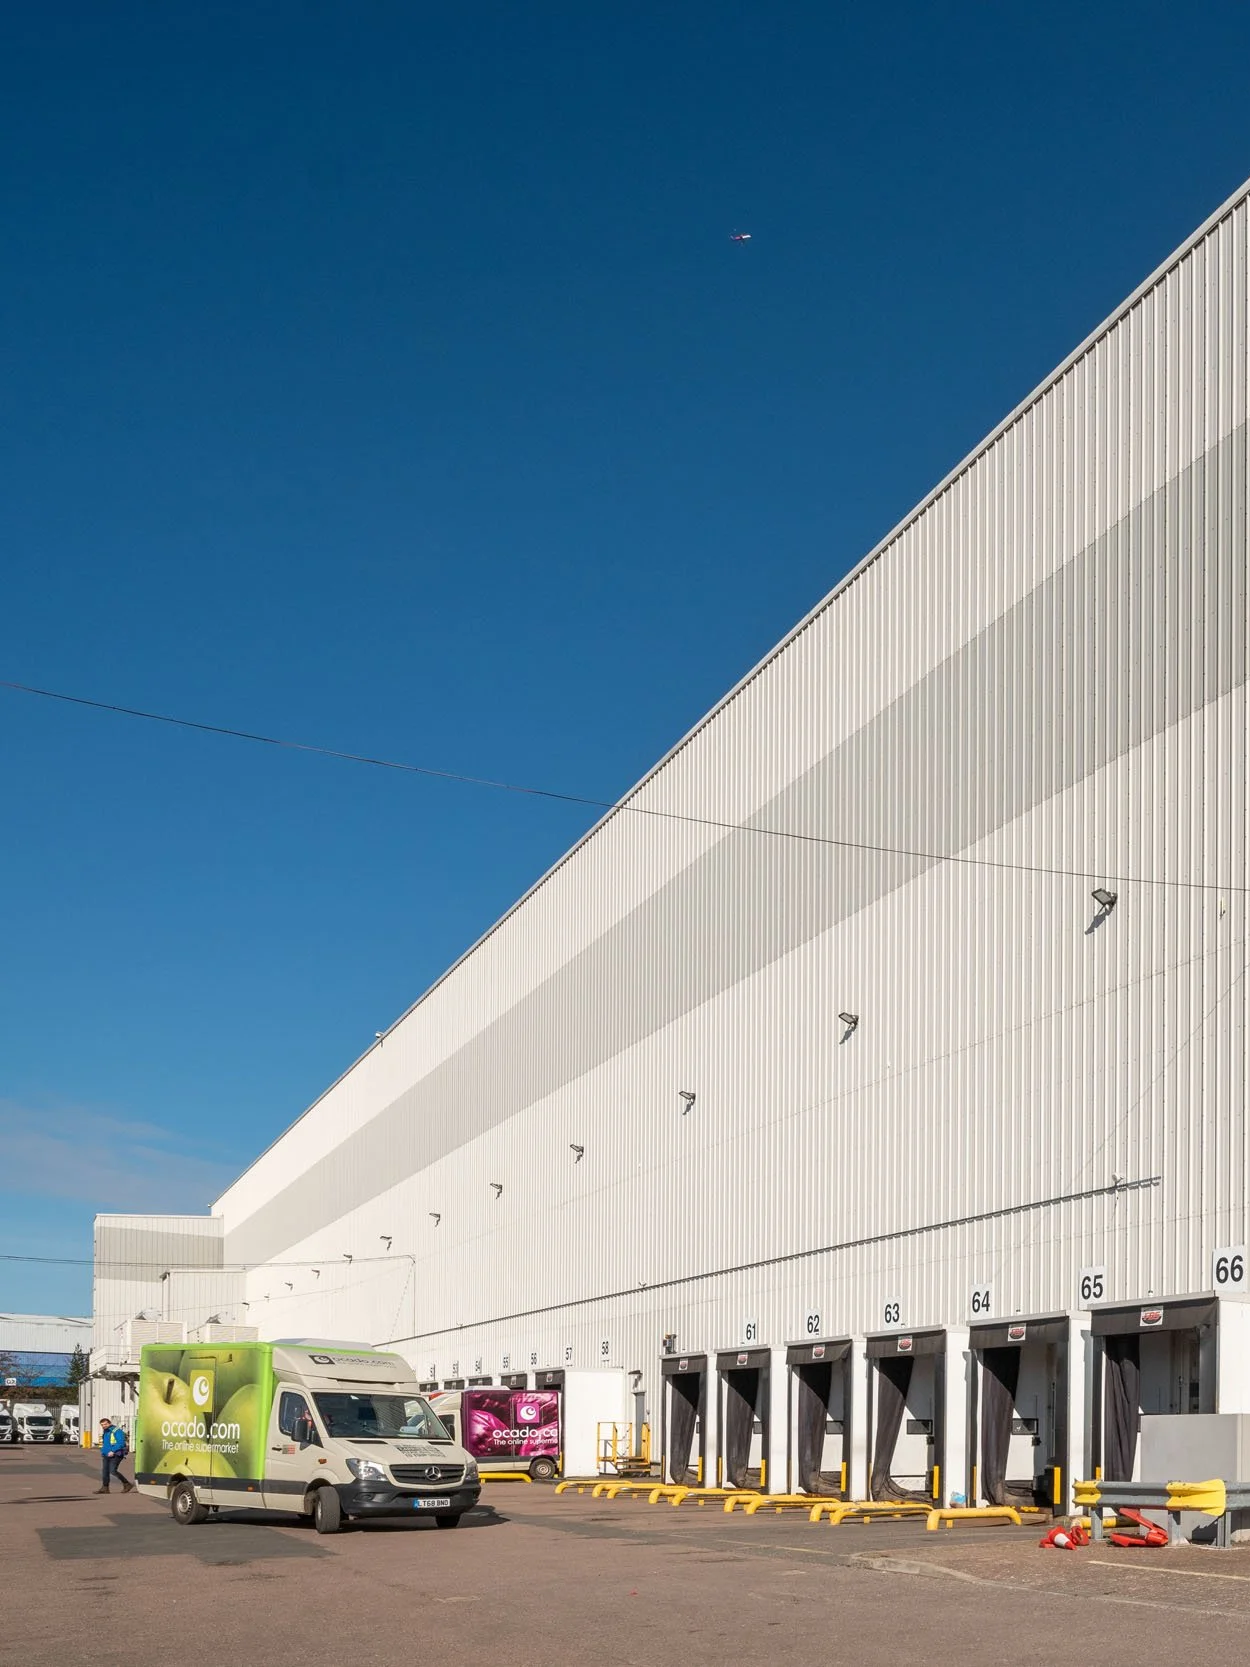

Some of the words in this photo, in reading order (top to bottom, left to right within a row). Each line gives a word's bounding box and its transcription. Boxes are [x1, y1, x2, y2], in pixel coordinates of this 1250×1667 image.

[1216, 1255, 1244, 1284] 66
[1081, 1275, 1104, 1300] 65
[971, 1291, 991, 1312] 64
[884, 1303, 900, 1323] 63
[746, 1323, 756, 1340] 61
[807, 1315, 820, 1333] 62
[565, 1347, 573, 1360] 57
[161, 1416, 240, 1439] ocado.com
[162, 1440, 173, 1451] The
[175, 1441, 193, 1452] online
[195, 1442, 239, 1454] supermarket
